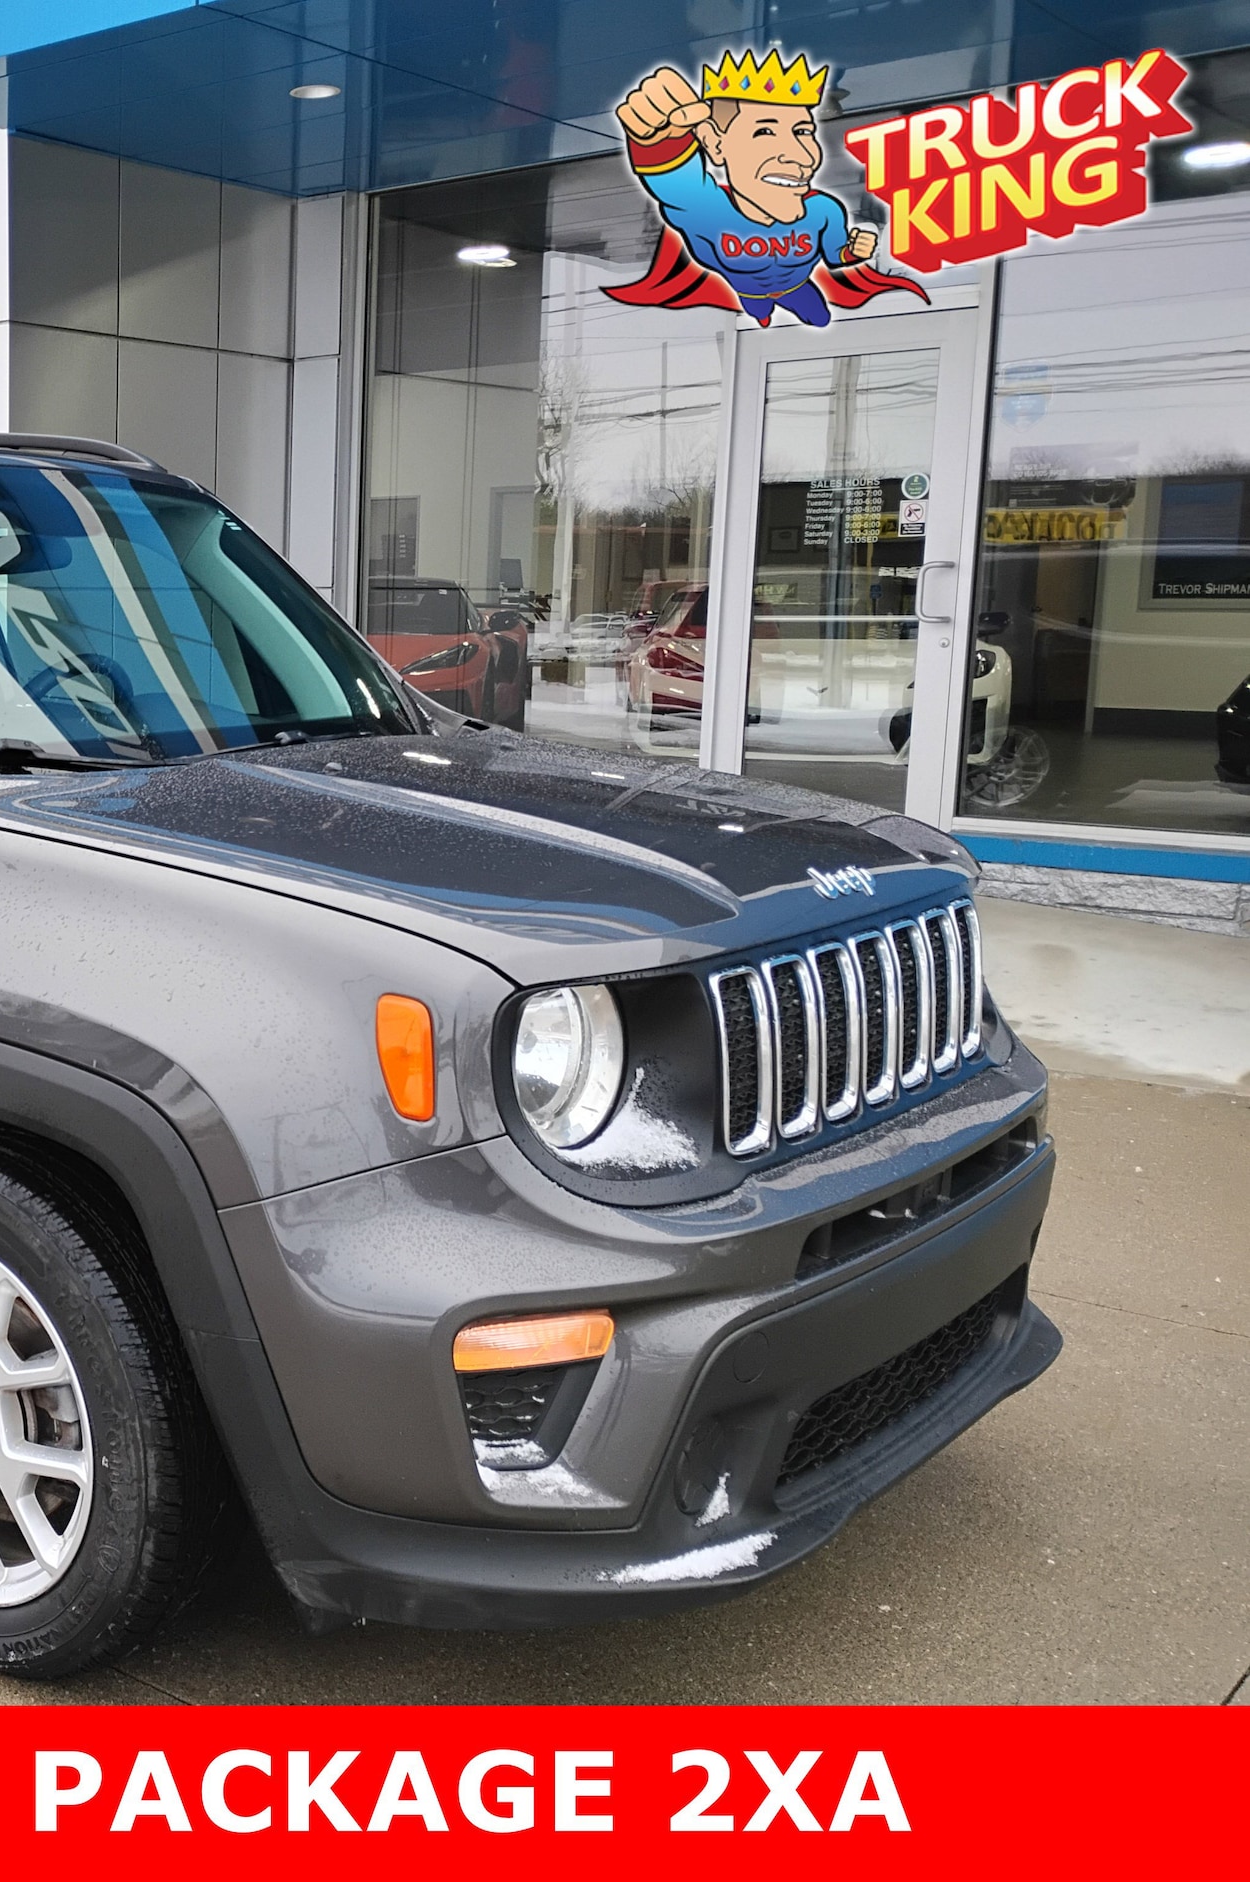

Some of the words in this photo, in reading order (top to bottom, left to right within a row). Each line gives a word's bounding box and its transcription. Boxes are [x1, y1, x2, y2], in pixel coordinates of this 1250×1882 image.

[810, 479, 842, 489] SALES
[845, 478, 881, 487] HOURS
[804, 522, 825, 530] Friday
[804, 530, 833, 538] Saturday
[803, 538, 828, 546] Sunday
[843, 536, 879, 544] CLOSED
[1158, 583, 1201, 595] TREVOR
[806, 865, 876, 900] Jeep
